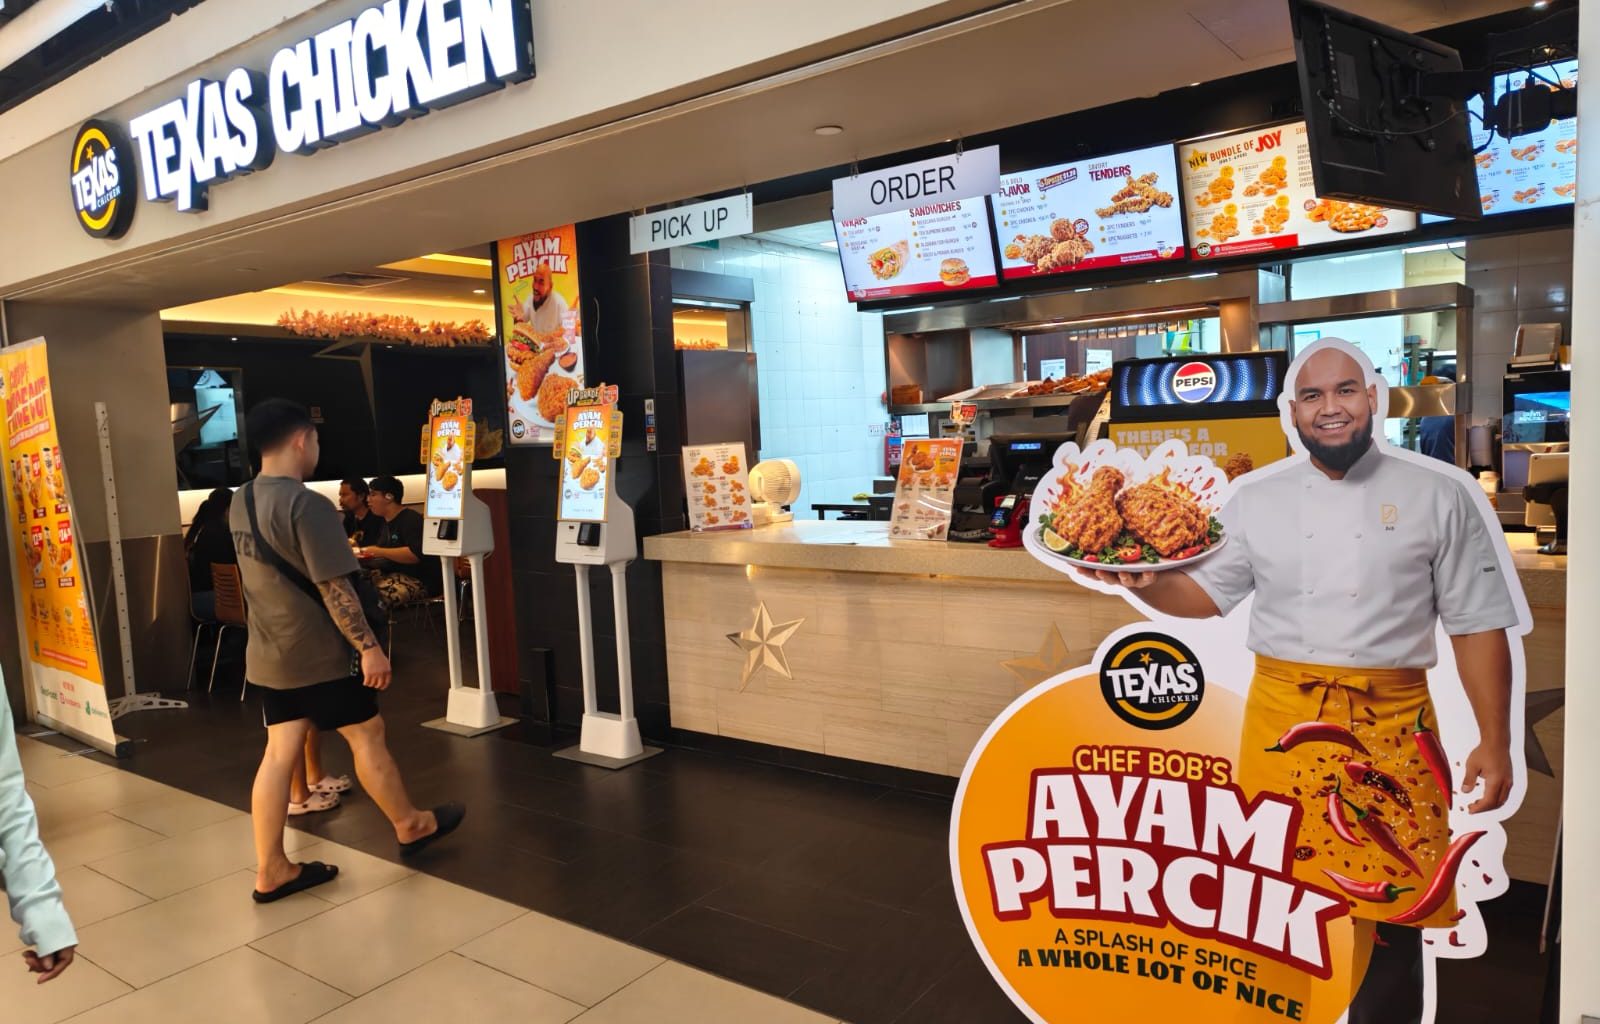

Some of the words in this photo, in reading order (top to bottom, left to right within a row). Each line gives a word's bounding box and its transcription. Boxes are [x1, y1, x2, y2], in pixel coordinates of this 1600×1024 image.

[129, 67, 258, 212] TEXAS
[268, 0, 518, 153] CHICKEN
[1189, 153, 1208, 169] NEW
[1210, 143, 1242, 162] BUNDLE
[1244, 140, 1254, 151] OF
[1255, 130, 1282, 153] JOY
[72, 147, 119, 212] TEXAS
[870, 165, 956, 205] ORDER
[999, 184, 1031, 198] FLAVOR
[1089, 164, 1132, 182] TENDERS
[96, 185, 121, 208] CHICKEN
[909, 201, 962, 218] SANDWICHES
[651, 213, 692, 242] PICK
[703, 207, 728, 232] UP
[513, 237, 561, 262] AYAM
[1175, 376, 1213, 388] PEPSI
[1116, 428, 1191, 444] THERE'S
[1197, 427, 1209, 442] A
[1188, 442, 1228, 456] FOR
[1105, 663, 1198, 704] TEXAS
[1152, 694, 1199, 704] CHICKEN
[1074, 747, 1140, 773] CHEF
[1148, 749, 1231, 785] BOB'S
[1031, 773, 1294, 873] AYAM
[987, 844, 1340, 969] PERCIK
[1054, 929, 1068, 944] A
[1074, 928, 1154, 955] SPLASH
[1160, 940, 1189, 960] OF
[1195, 948, 1258, 981] SPICE
[1017, 949, 1034, 967] A
[1038, 948, 1130, 974] WHOLE
[1137, 956, 1186, 984] LOT
[1192, 970, 1229, 995] OF
[1236, 980, 1304, 1022] NICE
